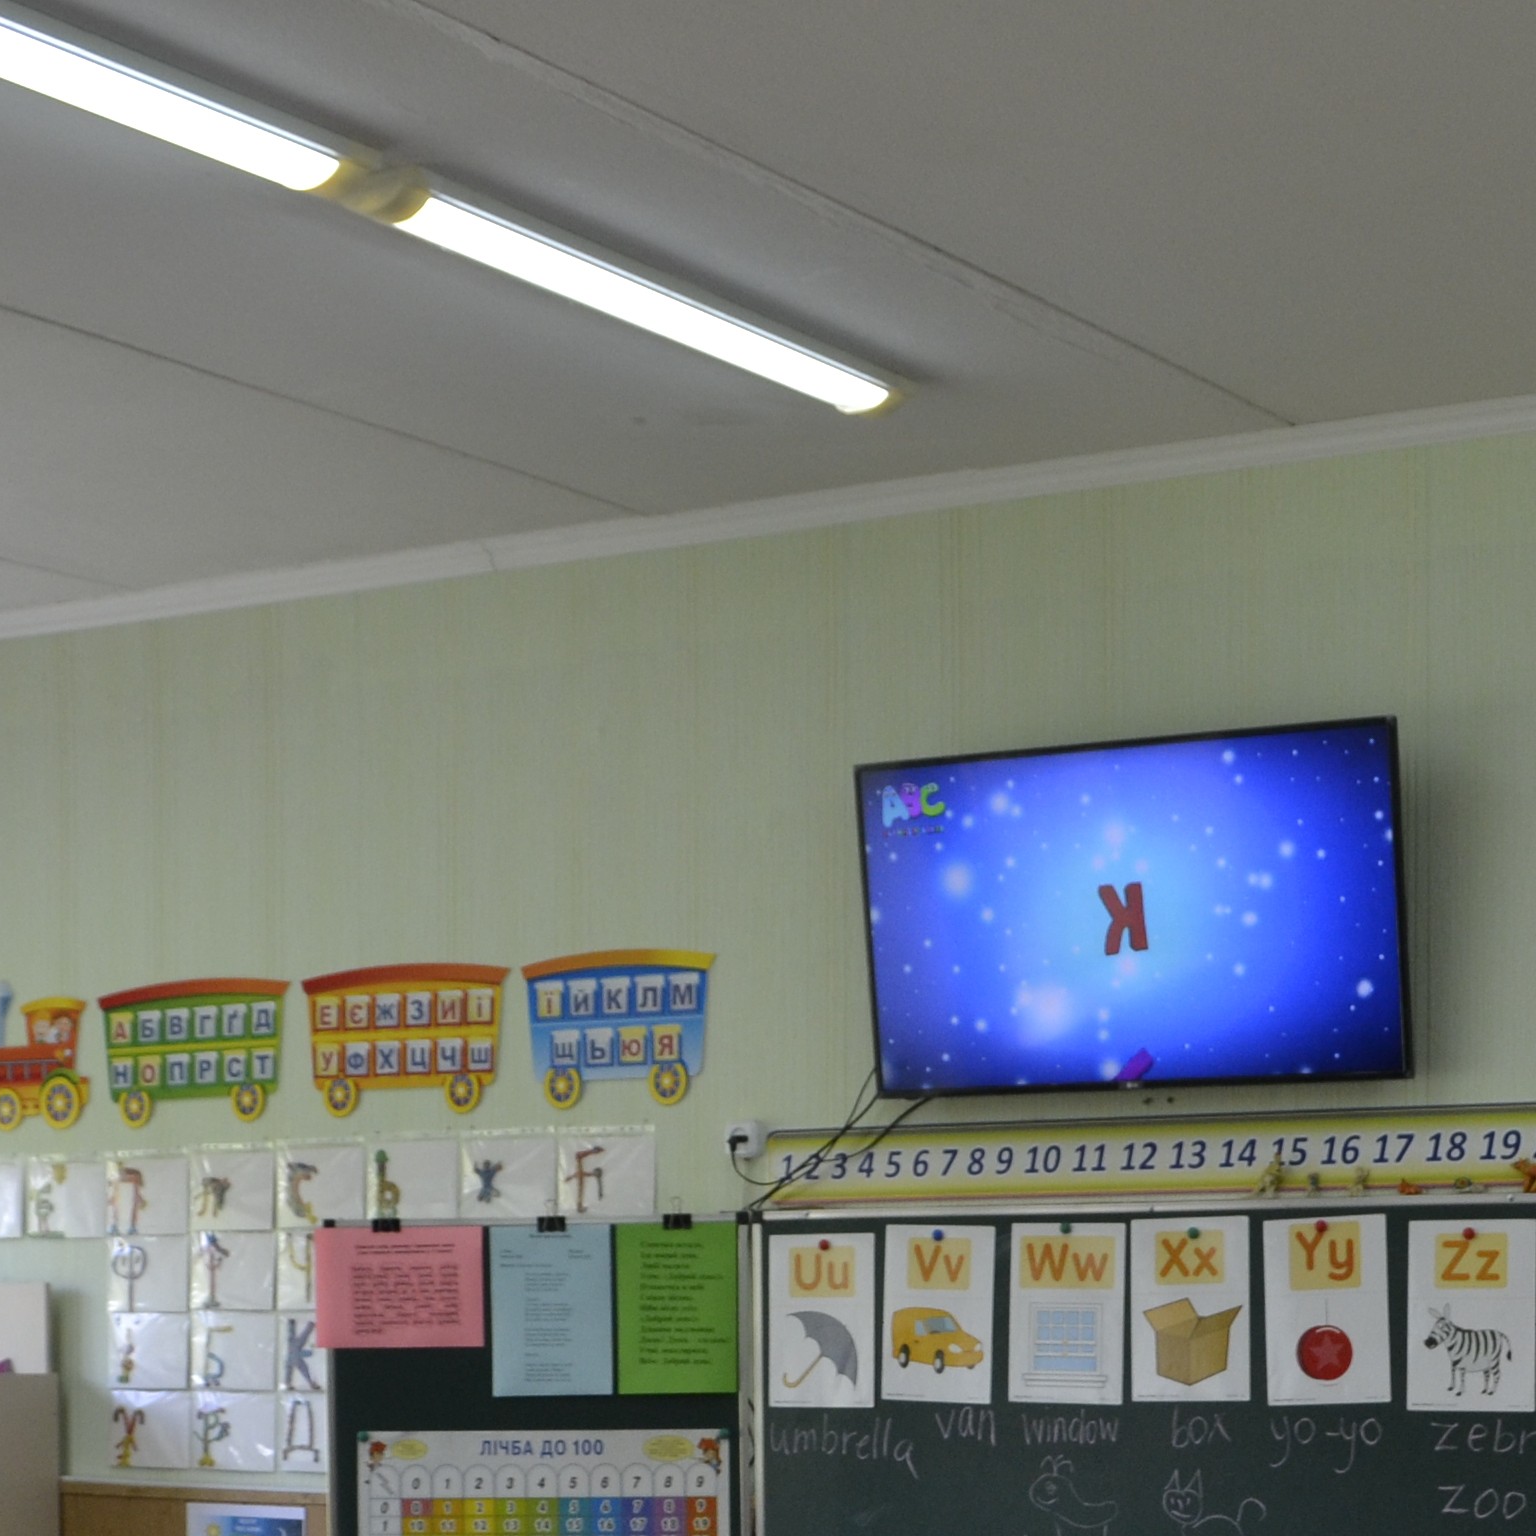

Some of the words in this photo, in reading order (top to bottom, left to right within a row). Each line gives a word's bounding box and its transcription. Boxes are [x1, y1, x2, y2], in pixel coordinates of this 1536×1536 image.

[321, 1006, 331, 1025] Е
[376, 1004, 394, 1021] Ж
[441, 999, 455, 1017] И
[575, 990, 589, 1012] Й
[608, 989, 622, 1009] К
[640, 986, 658, 1006] Л
[673, 985, 693, 1004] М
[115, 1023, 127, 1040] А
[142, 1019, 155, 1037] Б
[171, 1017, 183, 1034] В
[200, 1016, 211, 1034] Г
[255, 1009, 272, 1031] Д
[322, 1052, 334, 1070] У
[348, 1052, 364, 1070] Ф
[379, 1050, 394, 1068] Х
[411, 1049, 426, 1069] Ц
[442, 1047, 456, 1064] Ч
[471, 1047, 489, 1063] Ш
[556, 1041, 574, 1060] Щ
[592, 1040, 606, 1059] Ь
[622, 1037, 641, 1055] Ю
[659, 1035, 674, 1055] Я
[116, 1065, 129, 1083] Н
[143, 1064, 155, 1082] О
[170, 1063, 183, 1080] П
[201, 1061, 211, 1079] Р
[228, 1059, 241, 1077] С
[256, 1056, 270, 1073] Т
[832, 1154, 848, 1179] 3
[858, 1152, 874, 1178] 4
[886, 1151, 902, 1177] 5
[913, 1150, 930, 1176] 6
[943, 1150, 958, 1175] 7
[968, 1149, 986, 1175] 8
[997, 1148, 1014, 1174] 9
[1025, 1146, 1062, 1173] 10
[1073, 1144, 1107, 1171] 11
[1121, 1143, 1157, 1170] 12
[1170, 1141, 1206, 1168] 13
[1220, 1140, 1257, 1167] 14
[1271, 1138, 1308, 1165] 15
[1322, 1136, 1360, 1164] 16
[1374, 1134, 1414, 1163] 17
[1426, 1132, 1467, 1161] 18
[1480, 1131, 1522, 1160] 19
[795, 1254, 849, 1291] Uu
[914, 1245, 965, 1282] Vv
[1027, 1243, 1109, 1282] Ww
[1160, 1238, 1218, 1277] Xx
[1296, 1231, 1354, 1280] Yy
[1442, 1240, 1500, 1281] Zz
[936, 1406, 996, 1446] van
[1022, 1409, 1119, 1445] window
[1171, 1407, 1231, 1449] box
[480, 1440, 534, 1456] ЛІЧБА
[540, 1439, 566, 1457] ДО
[573, 1439, 604, 1456] 100
[771, 1414, 920, 1480] umbrella
[1270, 1416, 1383, 1474] yo-yo
[412, 1477, 421, 1489] 0
[443, 1477, 452, 1489] 1
[474, 1477, 483, 1489] 2
[505, 1477, 515, 1489] 3
[537, 1477, 547, 1489] 4
[568, 1477, 578, 1489] 5
[600, 1477, 610, 1489] 6
[632, 1477, 641, 1489] 7
[664, 1477, 673, 1489] 8
[696, 1477, 705, 1489] 9
